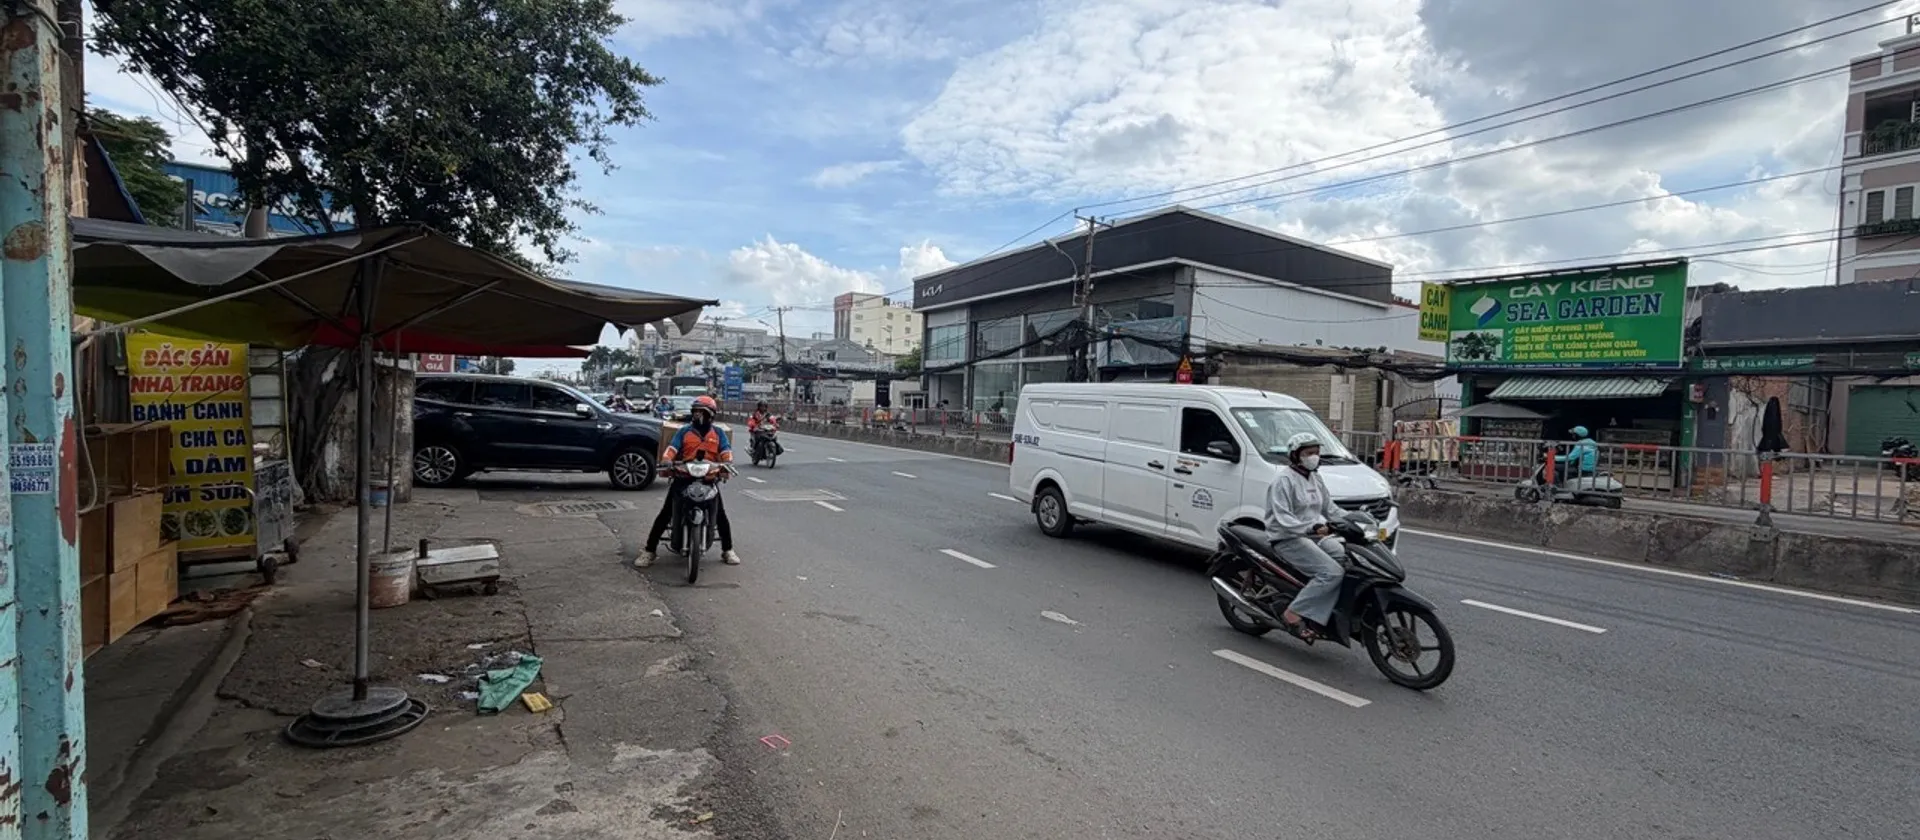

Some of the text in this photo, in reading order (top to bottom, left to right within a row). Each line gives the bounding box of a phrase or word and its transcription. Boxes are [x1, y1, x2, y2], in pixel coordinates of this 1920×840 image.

[1509, 282, 1562, 299] CÂY
[1507, 292, 1664, 322] SEA GARDEN
[144, 344, 229, 372] ĐẶC SẢN
[131, 375, 245, 393] NHA TRANG
[133, 401, 243, 421] BÁNH CANH
[180, 427, 217, 448] CHẢ
[224, 427, 246, 446] CÁ
